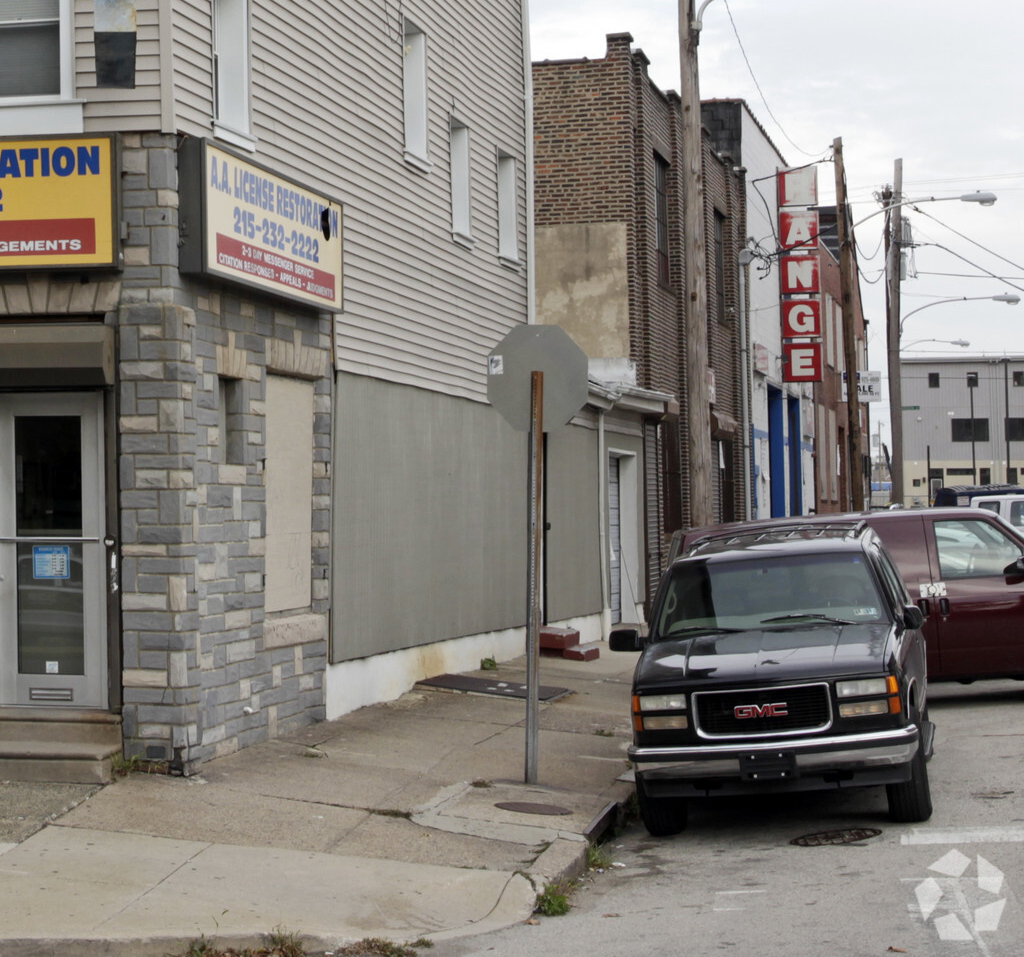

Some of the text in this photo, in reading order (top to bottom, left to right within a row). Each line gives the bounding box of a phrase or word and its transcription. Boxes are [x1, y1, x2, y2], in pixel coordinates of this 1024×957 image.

[210, 155, 232, 195] A.A.
[234, 166, 275, 212] LICENSE
[233, 206, 320, 263] 215-232-2222
[218, 252, 243, 270] CITATION
[279, 272, 302, 288] APPEALS
[263, 253, 294, 272] MESSENGER
[294, 264, 315, 279] SERVICE
[857, 384, 874, 393] ALE
[734, 702, 789, 719] GMC
